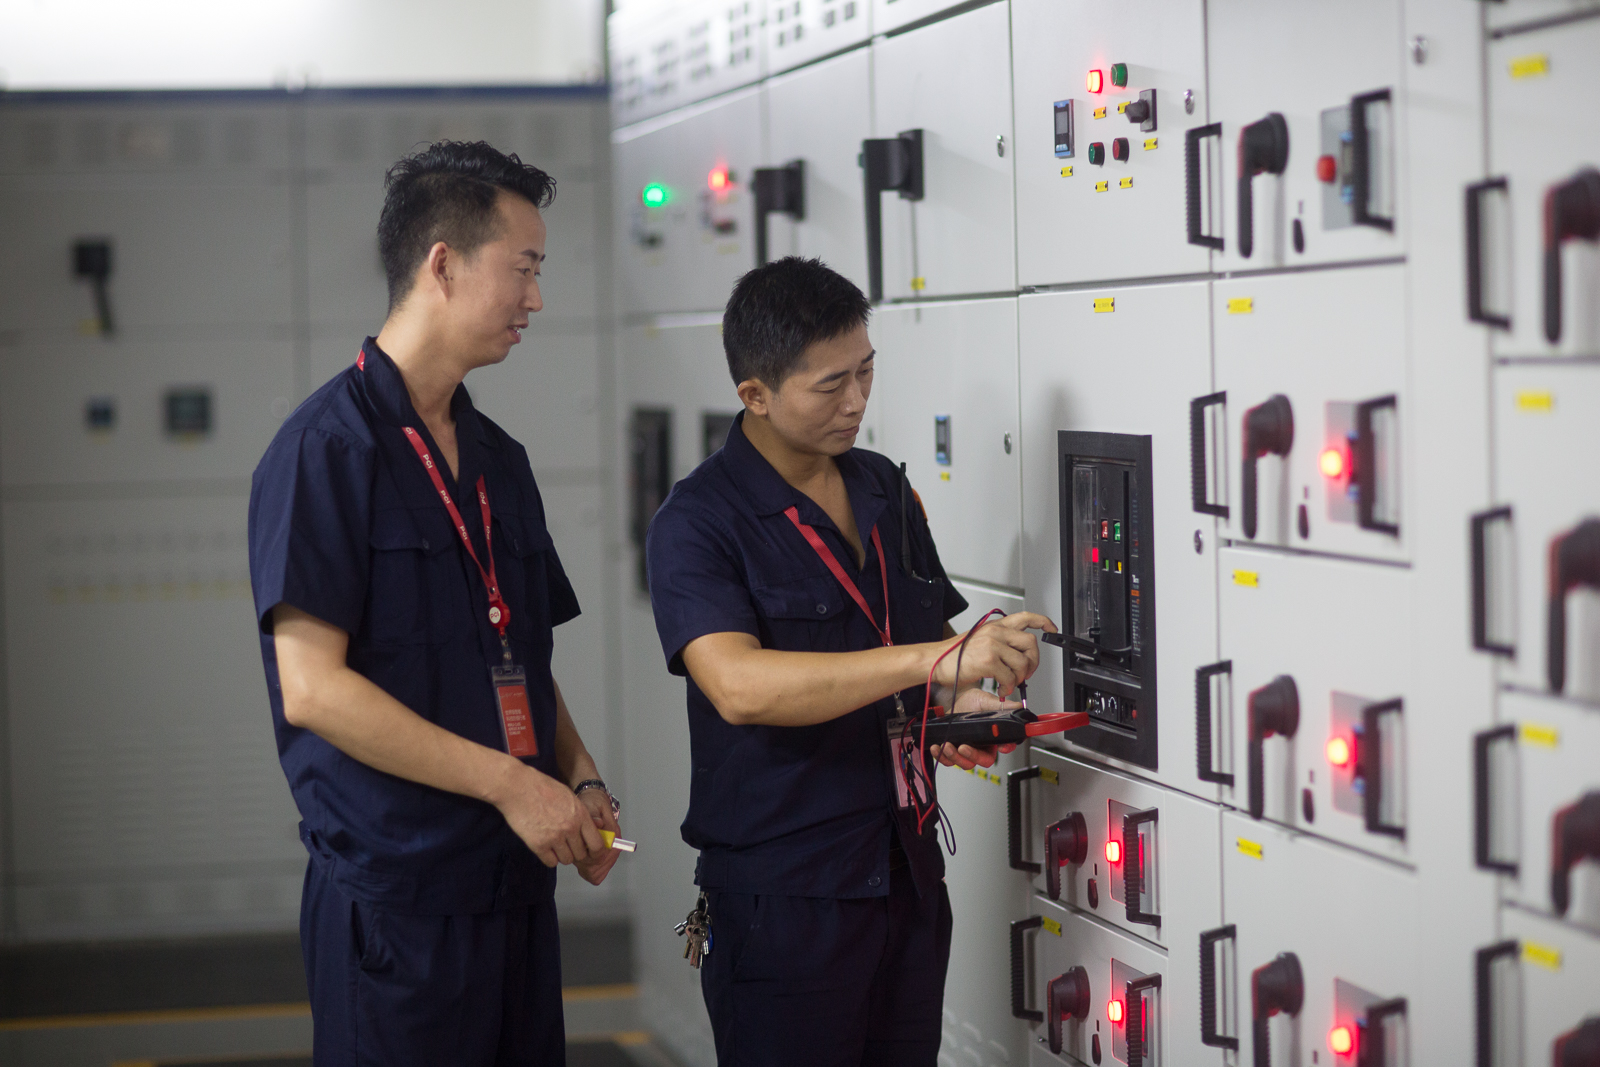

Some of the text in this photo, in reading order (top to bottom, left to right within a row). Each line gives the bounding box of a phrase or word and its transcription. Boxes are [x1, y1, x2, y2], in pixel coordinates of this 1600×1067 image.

[405, 426, 414, 435] CI
[423, 454, 433, 469] PCI
[440, 490, 451, 504] PCI
[459, 525, 468, 540] PCI
[490, 611, 499, 619] PCI
